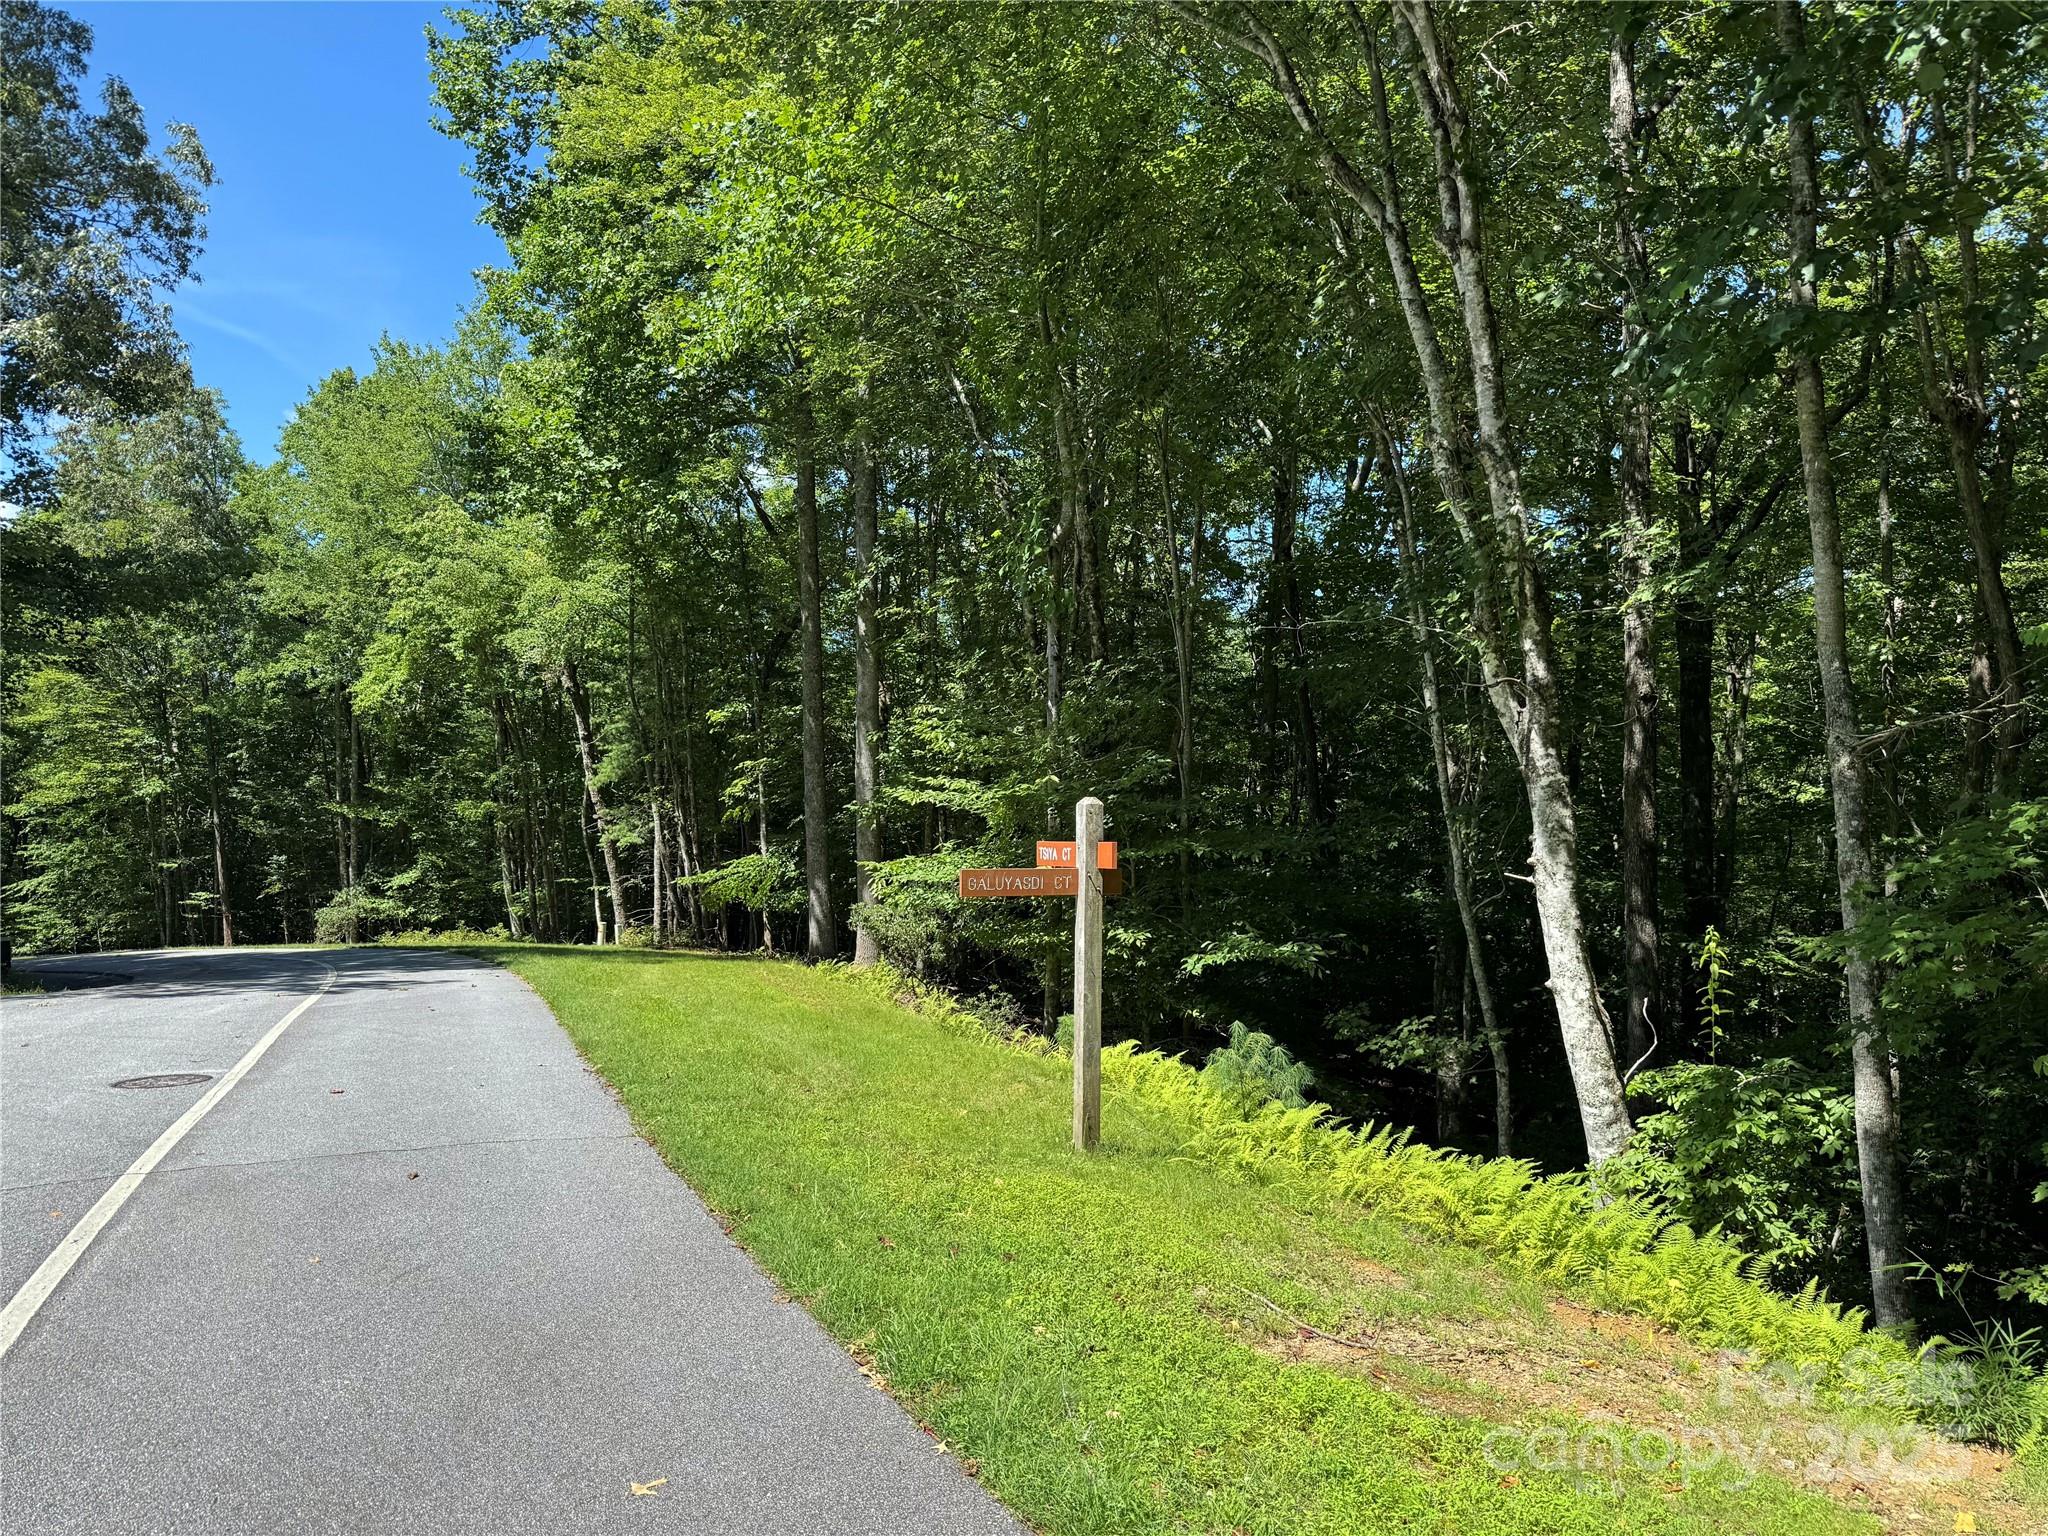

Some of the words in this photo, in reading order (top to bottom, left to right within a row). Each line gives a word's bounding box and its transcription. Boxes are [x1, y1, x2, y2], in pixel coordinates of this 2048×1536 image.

[1062, 848, 1072, 862] CT
[968, 876, 1044, 890] GALUYASDI
[1054, 875, 1072, 889] CT
